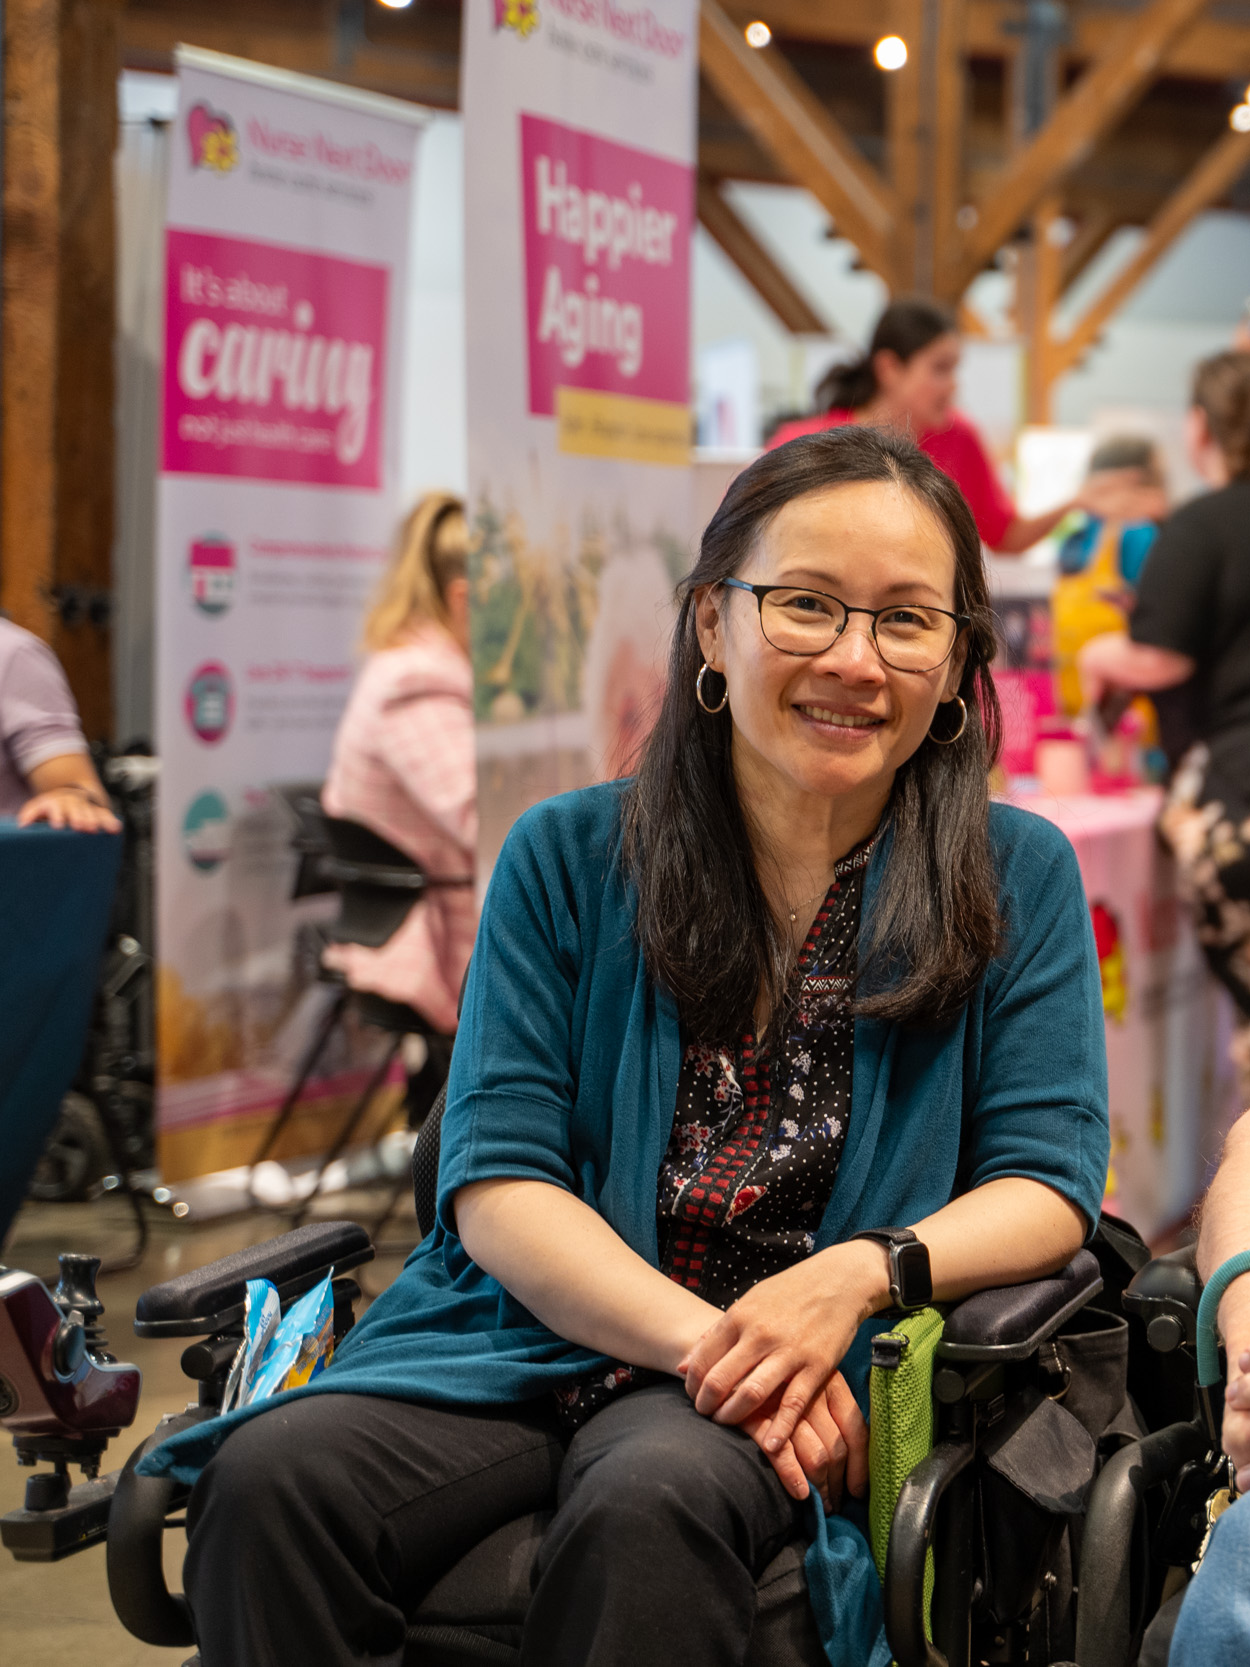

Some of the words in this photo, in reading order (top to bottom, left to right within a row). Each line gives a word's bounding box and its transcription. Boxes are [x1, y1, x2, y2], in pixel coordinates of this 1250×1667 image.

[640, 8, 684, 60] Door
[247, 116, 307, 162] Nurse
[361, 142, 412, 186] Door
[535, 154, 677, 269] Happier
[179, 263, 221, 309] It's
[225, 272, 289, 317] about
[537, 264, 644, 377] Aging
[178, 299, 374, 465] caring
